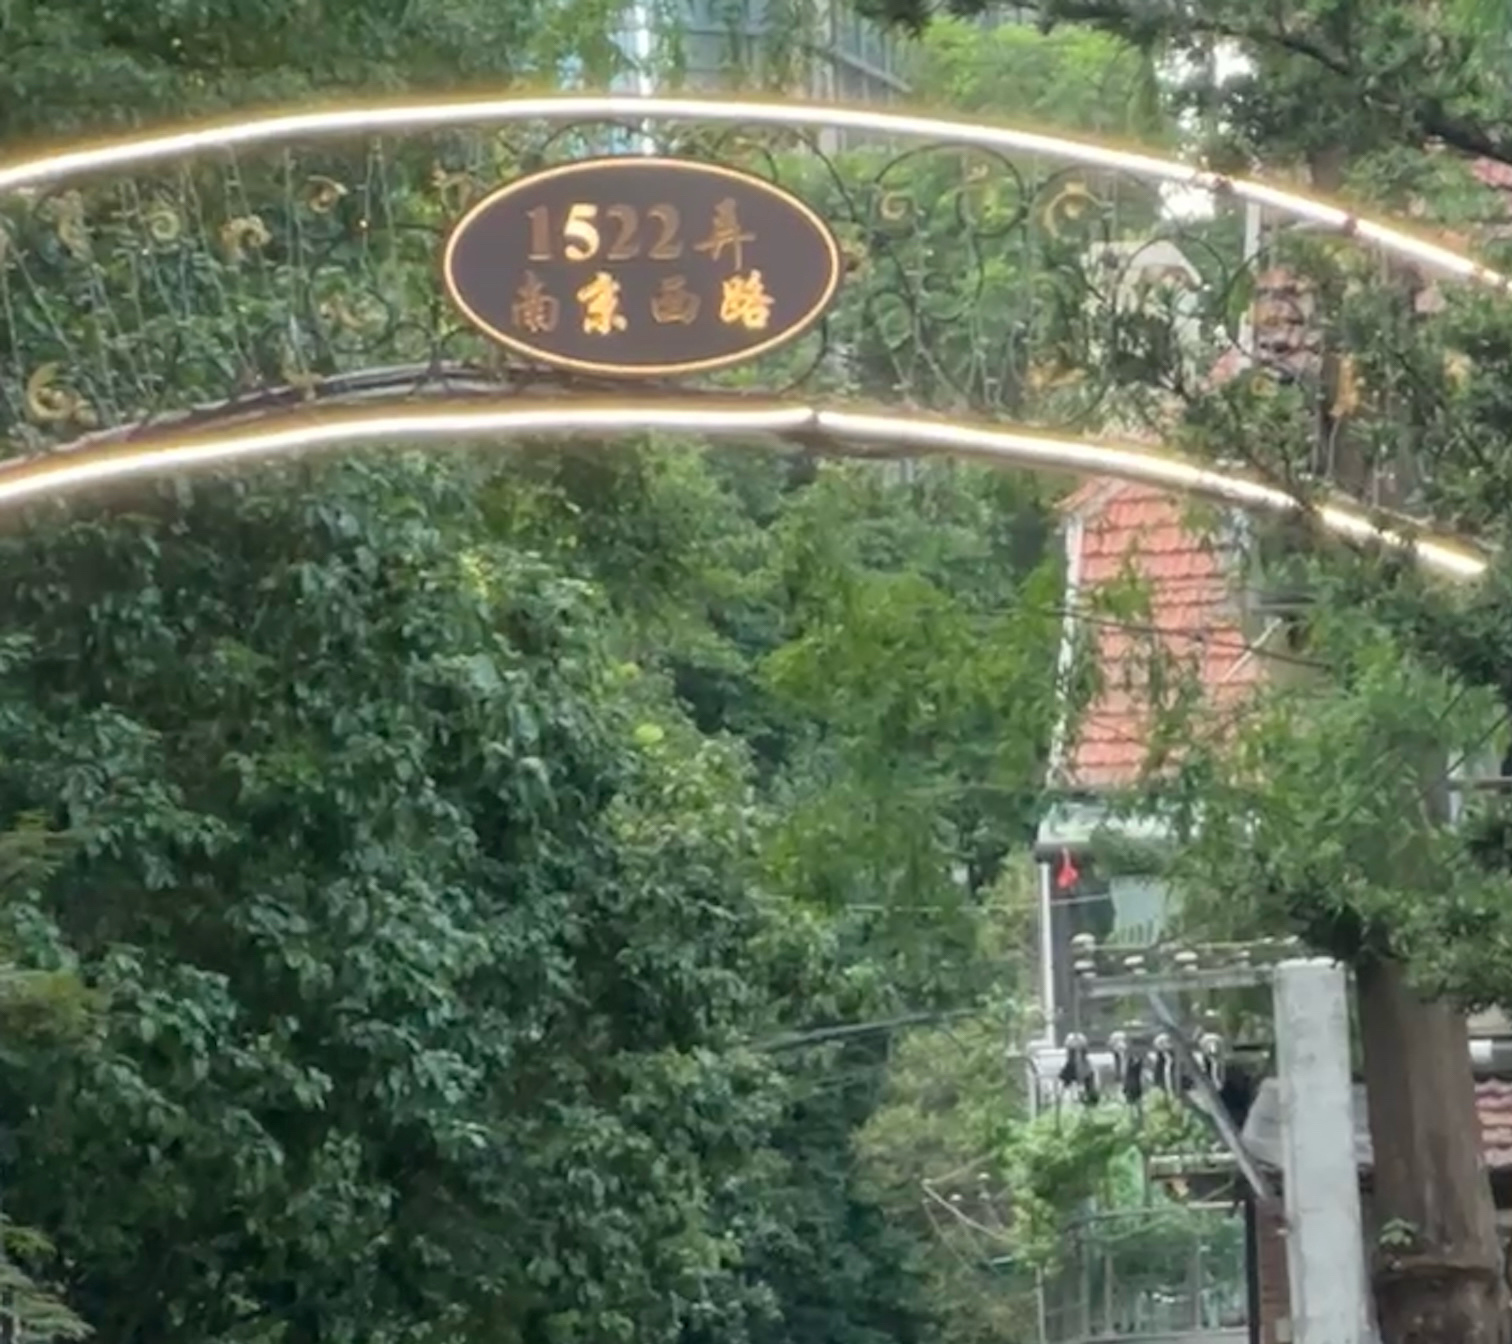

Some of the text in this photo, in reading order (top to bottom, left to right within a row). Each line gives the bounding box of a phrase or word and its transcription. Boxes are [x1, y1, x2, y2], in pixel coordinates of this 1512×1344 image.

[525, 197, 755, 269] 1522弄
[511, 269, 774, 335] 南京西路
